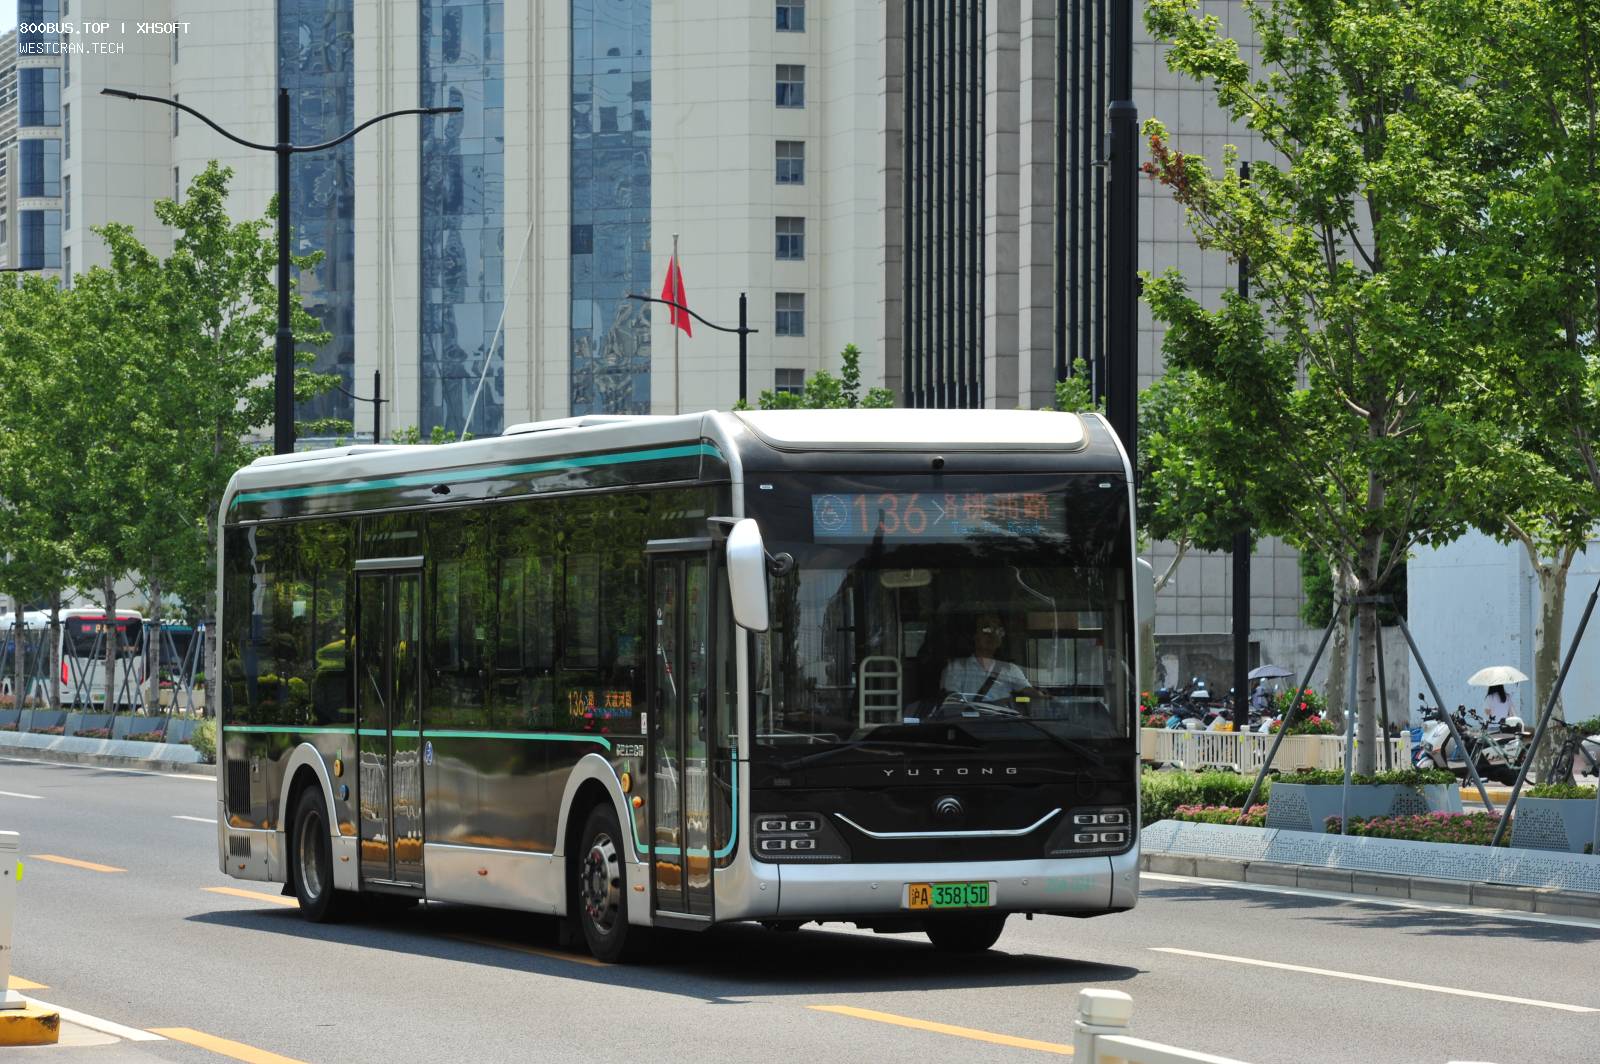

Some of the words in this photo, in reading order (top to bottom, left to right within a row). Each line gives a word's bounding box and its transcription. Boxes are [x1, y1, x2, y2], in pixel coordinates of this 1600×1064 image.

[853, 493, 928, 534] 136
[568, 691, 584, 716] 136
[883, 767, 1017, 777] YUTONG
